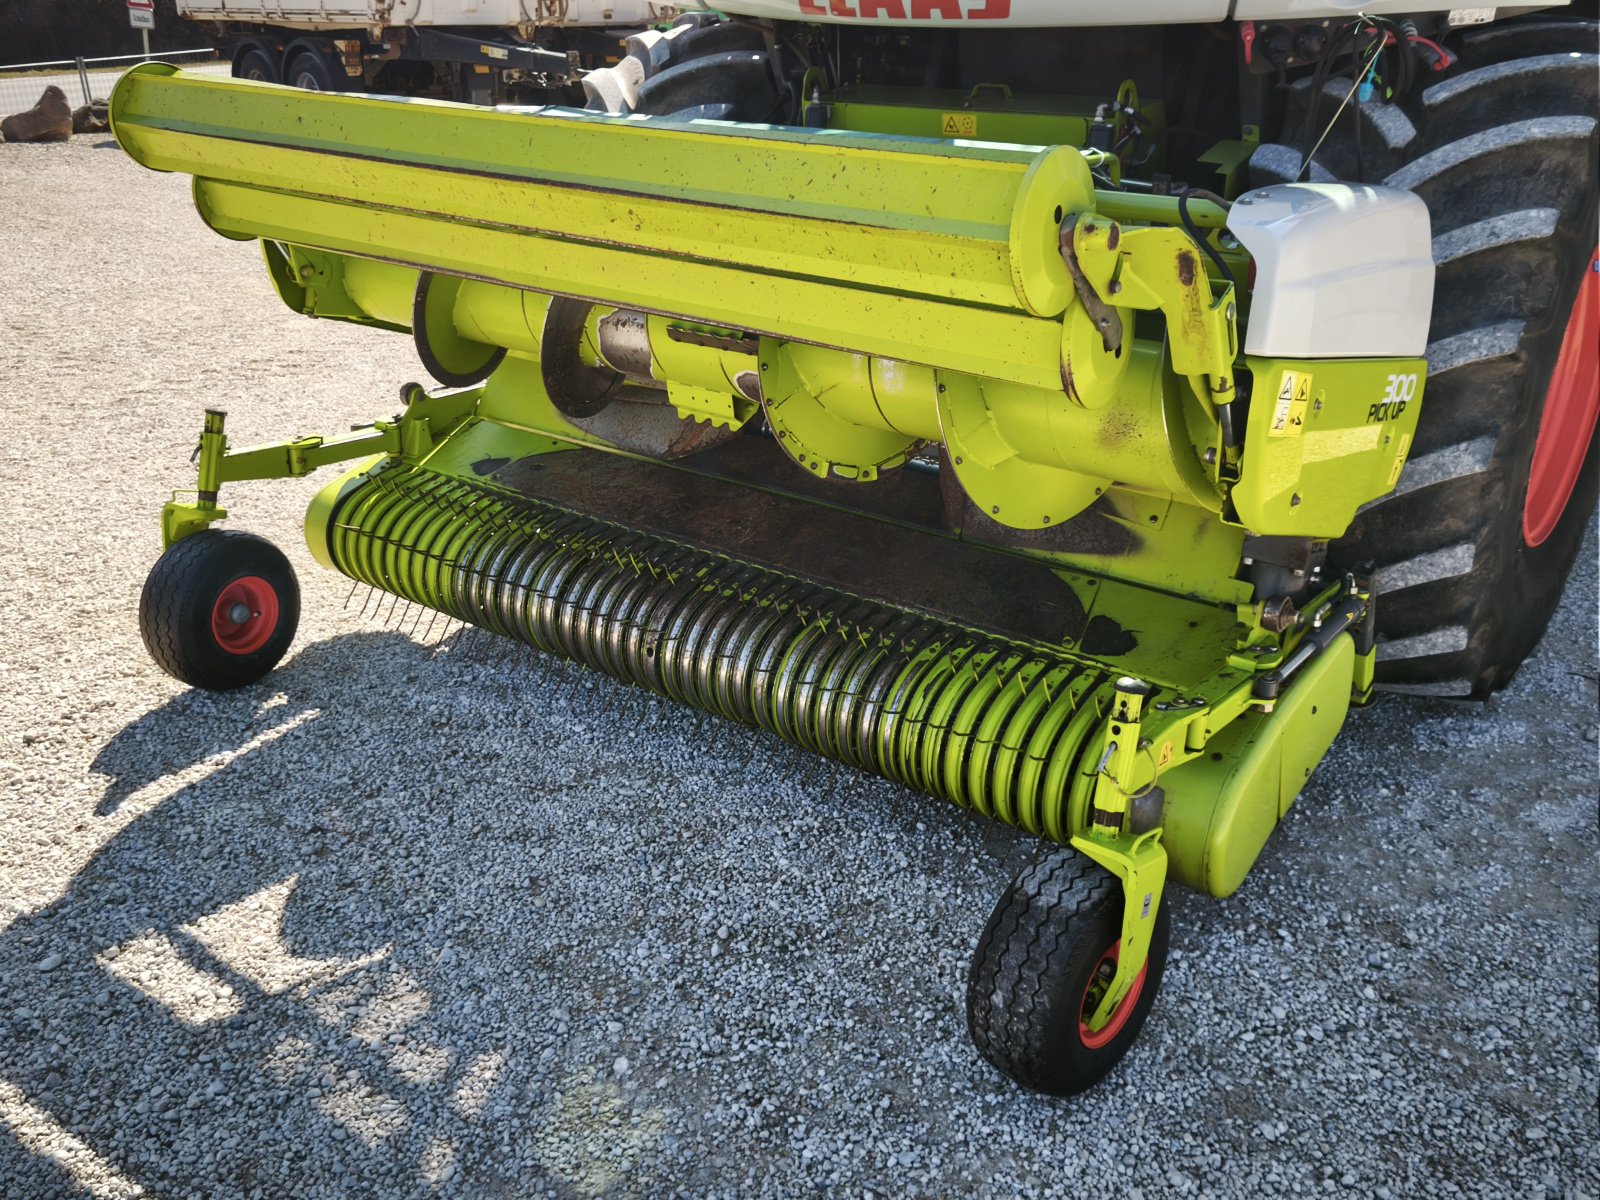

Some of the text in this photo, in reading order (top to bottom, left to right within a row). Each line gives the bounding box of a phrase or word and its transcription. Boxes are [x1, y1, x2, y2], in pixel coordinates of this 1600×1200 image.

[1381, 373, 1417, 403] 300
[1366, 400, 1406, 424] PICK UP
